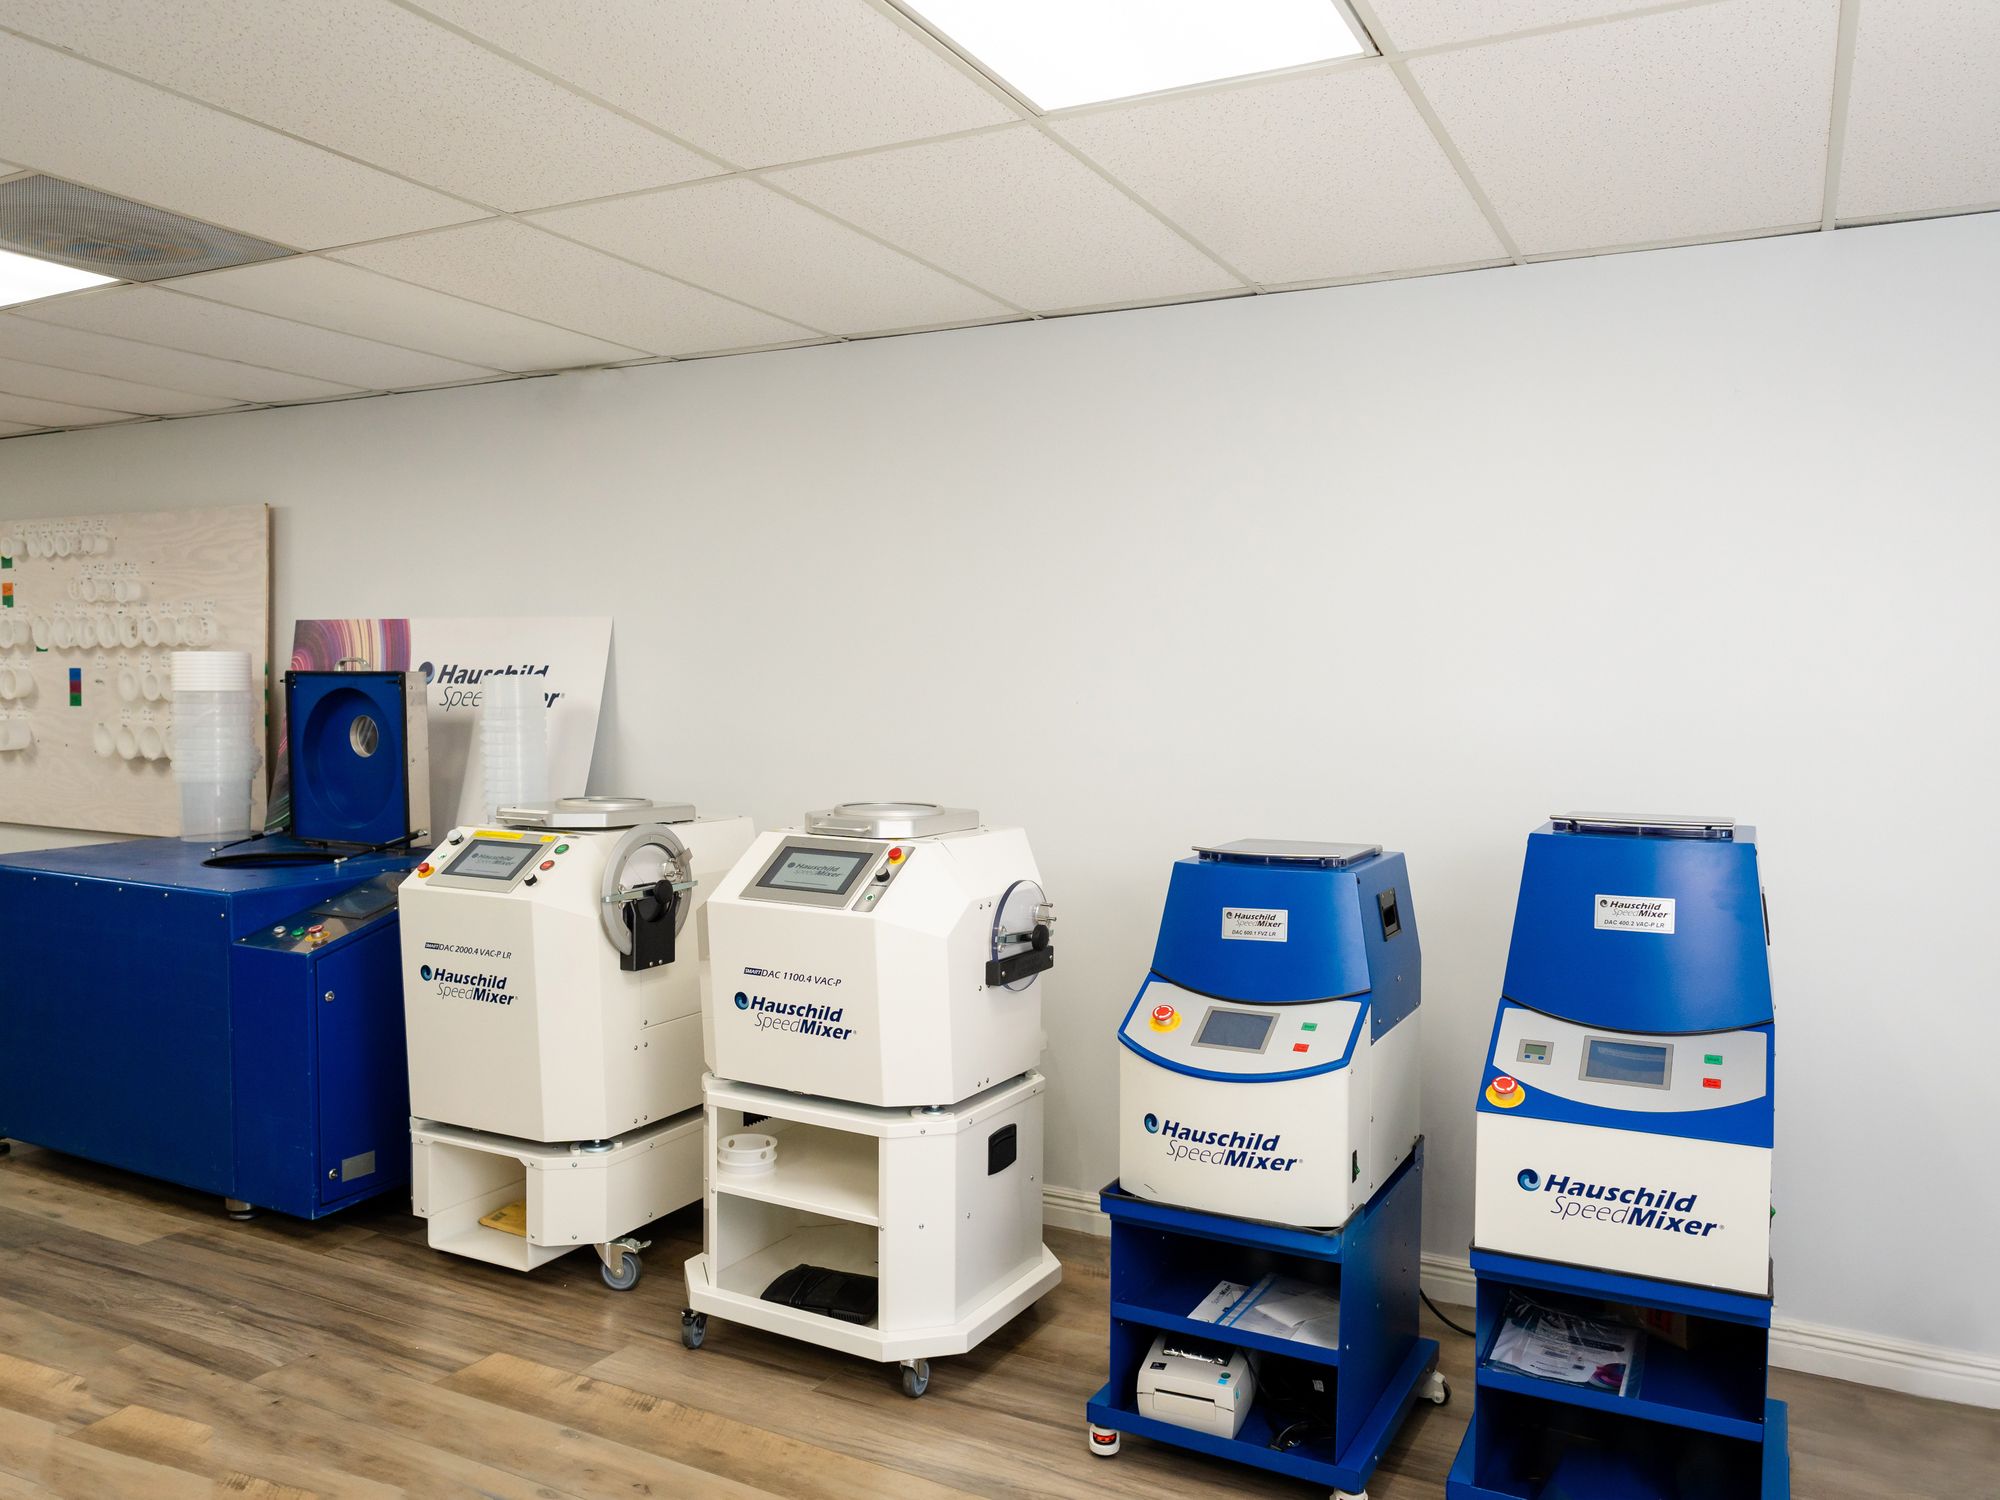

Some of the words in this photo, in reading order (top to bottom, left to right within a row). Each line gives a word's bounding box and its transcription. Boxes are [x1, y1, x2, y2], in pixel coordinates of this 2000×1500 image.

[795, 863, 841, 872] Hauschild
[1233, 912, 1277, 921] Hauschild
[1609, 900, 1662, 911] Hauschild
[1611, 908, 1668, 918] SpeedMixer
[1235, 919, 1282, 928] SpeedMixer
[454, 945, 479, 955] 2000.4
[479, 948, 502, 958] VAC-P
[502, 951, 512, 960] LR
[433, 967, 508, 990] Hauschild
[783, 972, 812, 983] 1100.4
[813, 976, 842, 987] VAC-P
[436, 982, 515, 1005] SpeedMixer
[750, 995, 844, 1023] Hauschild
[754, 1011, 853, 1041] SpeedMixer
[1161, 1119, 1281, 1152] Hauschild
[1166, 1139, 1298, 1172] SpeedMixer
[1543, 1174, 1698, 1213] Hauschild
[1550, 1195, 1718, 1237] SpeedMixer
